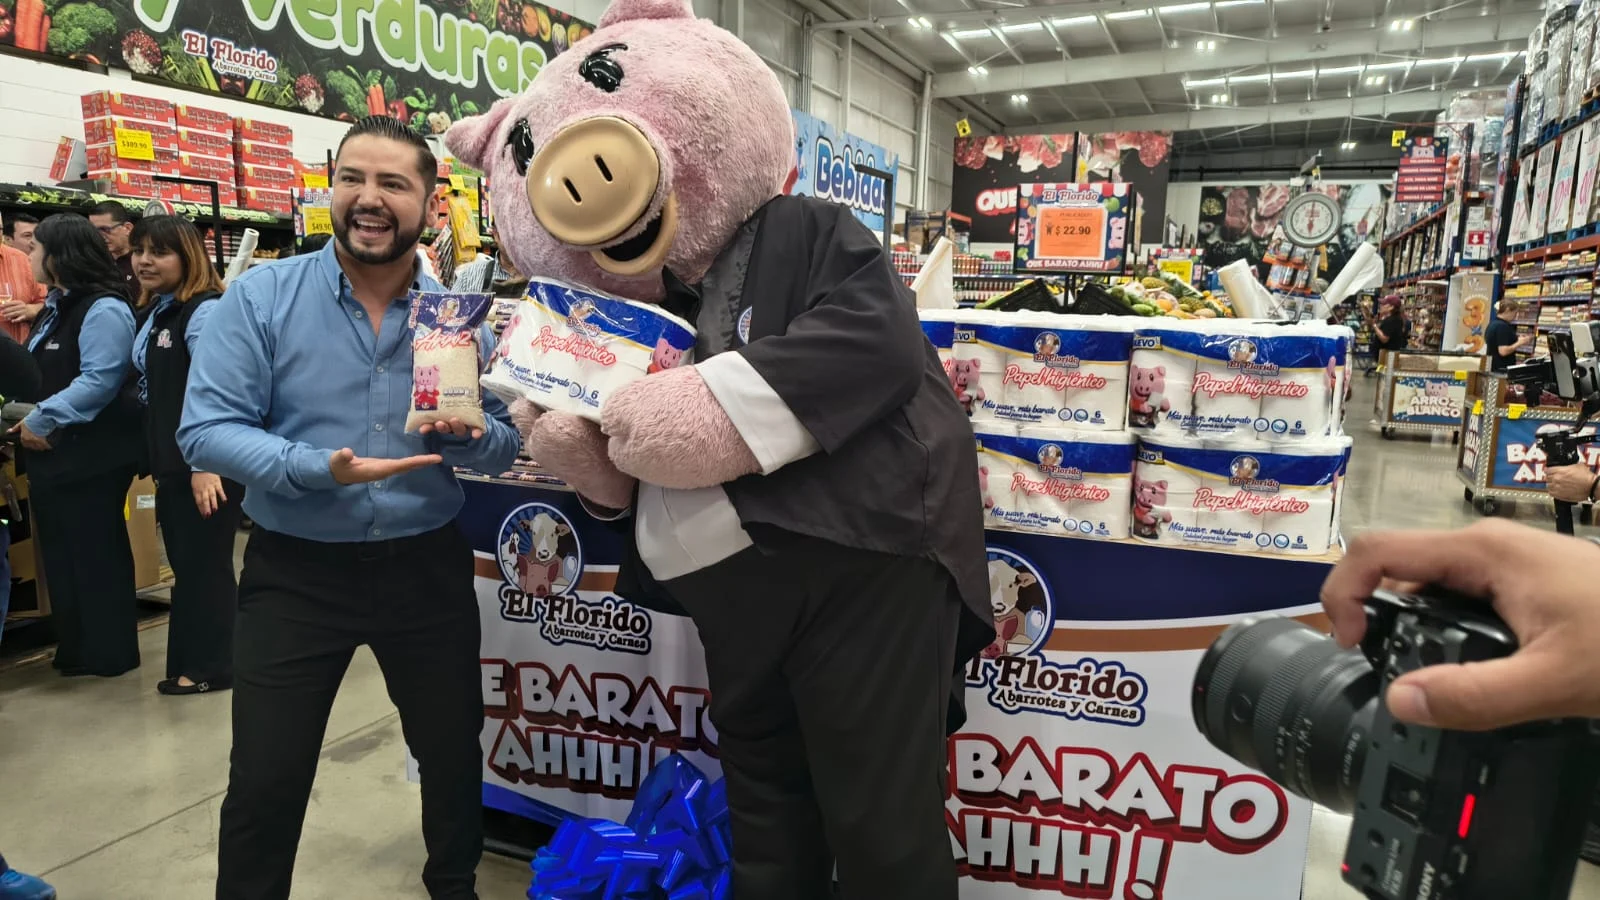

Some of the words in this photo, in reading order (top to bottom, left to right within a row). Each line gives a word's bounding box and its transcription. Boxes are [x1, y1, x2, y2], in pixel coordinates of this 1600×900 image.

[183, 32, 207, 55] El
[212, 40, 275, 72] Florido
[815, 136, 885, 215] Bebida
[1043, 191, 1056, 201] El
[1059, 190, 1098, 201] Florido
[1063, 226, 1091, 235] 22.90
[1034, 353, 1046, 362] El
[1046, 353, 1080, 364] Florido
[1228, 361, 1241, 369] El
[1243, 361, 1278, 372] Florido
[1003, 364, 1046, 390] Papel
[1045, 368, 1106, 392] higiénico
[1192, 372, 1240, 399] Papel
[1239, 374, 1310, 400] higiénico
[590, 390, 600, 400] 6
[1411, 395, 1460, 408] ARROZ
[982, 400, 996, 410] Más
[1031, 404, 1056, 415] barato
[1094, 410, 1102, 418] 6
[1406, 405, 1461, 418] BLANCO
[1167, 410, 1182, 420] Más
[1224, 413, 1252, 424] barato
[1295, 420, 1302, 429] 6
[1039, 464, 1050, 472] El
[1050, 466, 1081, 475] Florido
[1011, 472, 1051, 496] Papel
[1050, 478, 1110, 503] higiénico
[1230, 477, 1244, 486] El
[1243, 478, 1279, 487] Florido
[1193, 487, 1239, 511] Papel
[1238, 491, 1310, 516] higiénico
[991, 507, 1004, 517] Más
[1099, 521, 1106, 530] 6
[1168, 521, 1184, 532] Más
[1226, 526, 1254, 539] barato
[1296, 535, 1304, 543] 6
[503, 590, 535, 617] El
[544, 595, 647, 634] Florido
[545, 622, 596, 643] Abarrotes
[598, 632, 606, 645] y
[608, 632, 647, 649] Carnes
[994, 654, 1140, 702] Florido
[996, 689, 1067, 710] Abarrotes
[1069, 699, 1080, 715] y
[1085, 699, 1138, 720] Carnes
[953, 737, 1285, 846] BARATO
